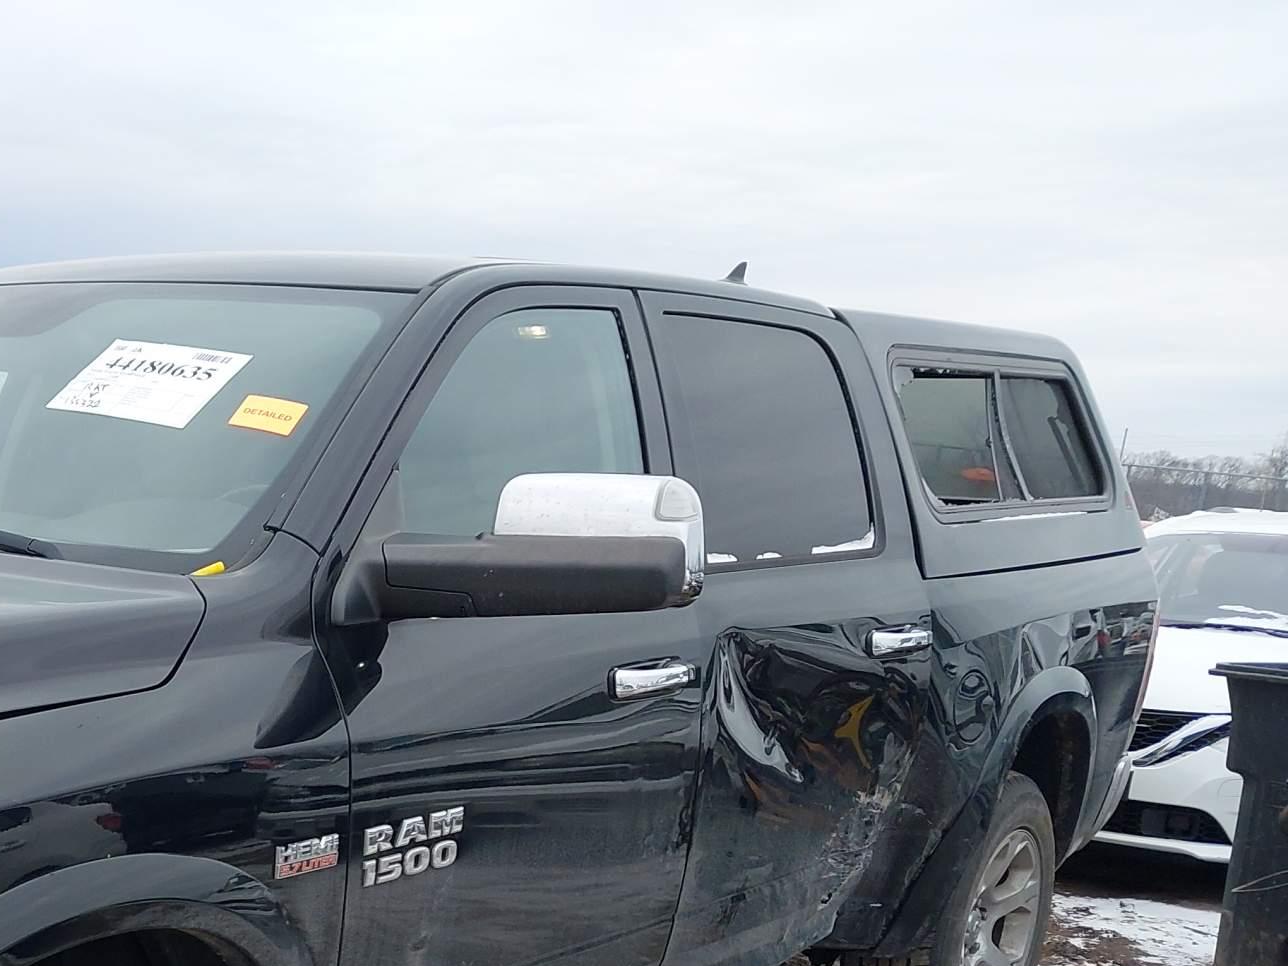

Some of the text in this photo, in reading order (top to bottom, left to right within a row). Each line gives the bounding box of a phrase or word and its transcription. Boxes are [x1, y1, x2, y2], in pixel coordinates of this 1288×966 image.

[105, 356, 218, 381] 44180635
[242, 407, 293, 422] DETAILED
[364, 807, 464, 856] RAM
[276, 833, 339, 864] HEMI
[362, 839, 459, 888] 1500
